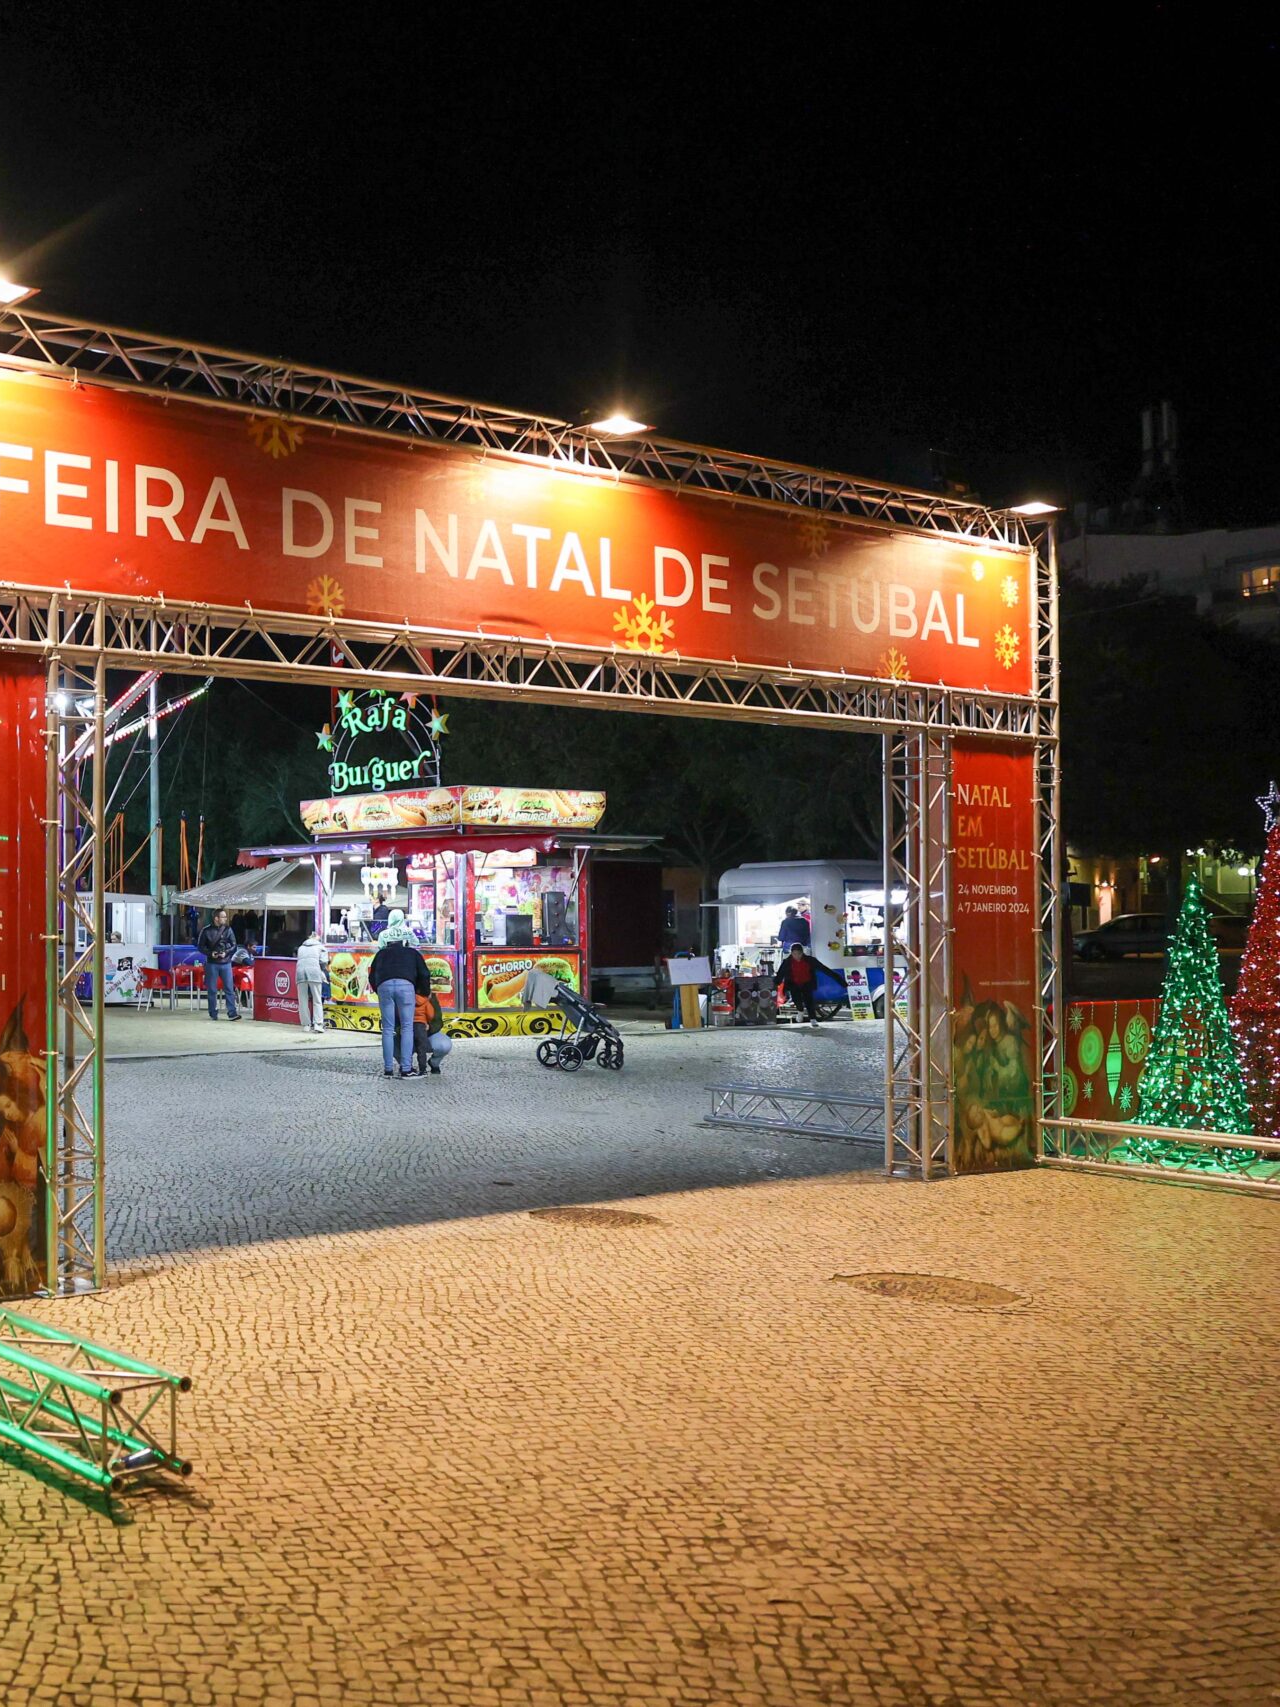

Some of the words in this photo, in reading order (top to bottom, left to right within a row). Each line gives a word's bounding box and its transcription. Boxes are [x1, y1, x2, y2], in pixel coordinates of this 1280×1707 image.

[281, 487, 384, 568] DE
[414, 508, 631, 602] NATAL
[654, 547, 732, 615] DE
[752, 562, 980, 648] SETÚBAL
[341, 697, 407, 738] Rafa
[328, 750, 432, 793] Burguer
[469, 790, 495, 802] KEBAB
[957, 783, 1012, 808] NATAL
[957, 815, 983, 837] EM
[957, 842, 1029, 871] SETÚBAL
[958, 884, 969, 896] 24
[972, 884, 1017, 896] NOVEMBRO
[957, 902, 964, 912] A
[965, 902, 971, 914] 7
[972, 903, 1007, 913] JANEIRO
[1009, 903, 1030, 914] 2024
[480, 959, 533, 975] CACHORRO
